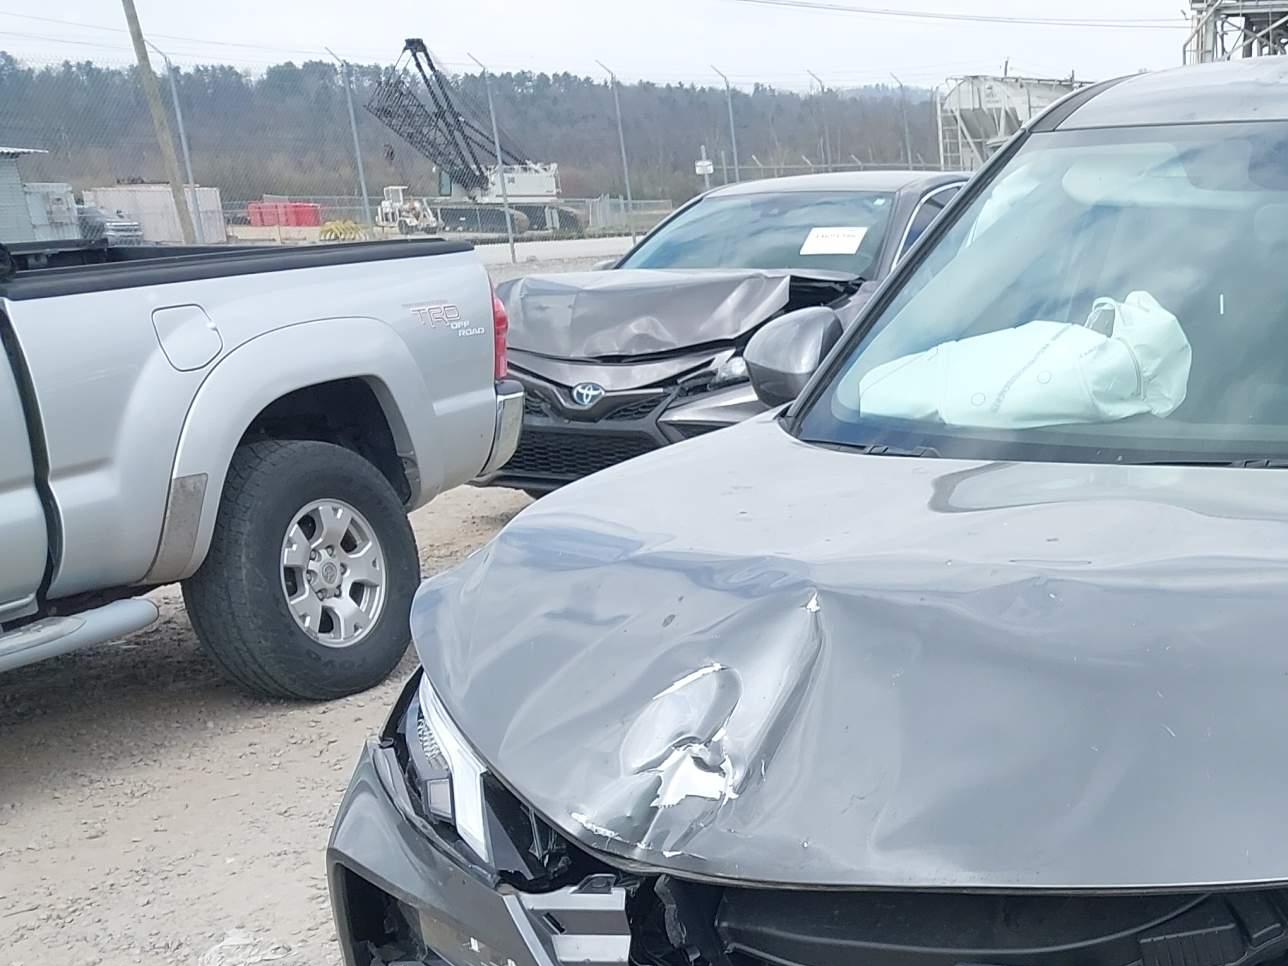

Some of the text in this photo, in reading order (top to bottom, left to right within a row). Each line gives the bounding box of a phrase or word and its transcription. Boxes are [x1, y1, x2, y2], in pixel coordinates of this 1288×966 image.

[409, 304, 461, 329] TRD
[450, 320, 470, 330] OFF
[458, 327, 485, 337] ROAD
